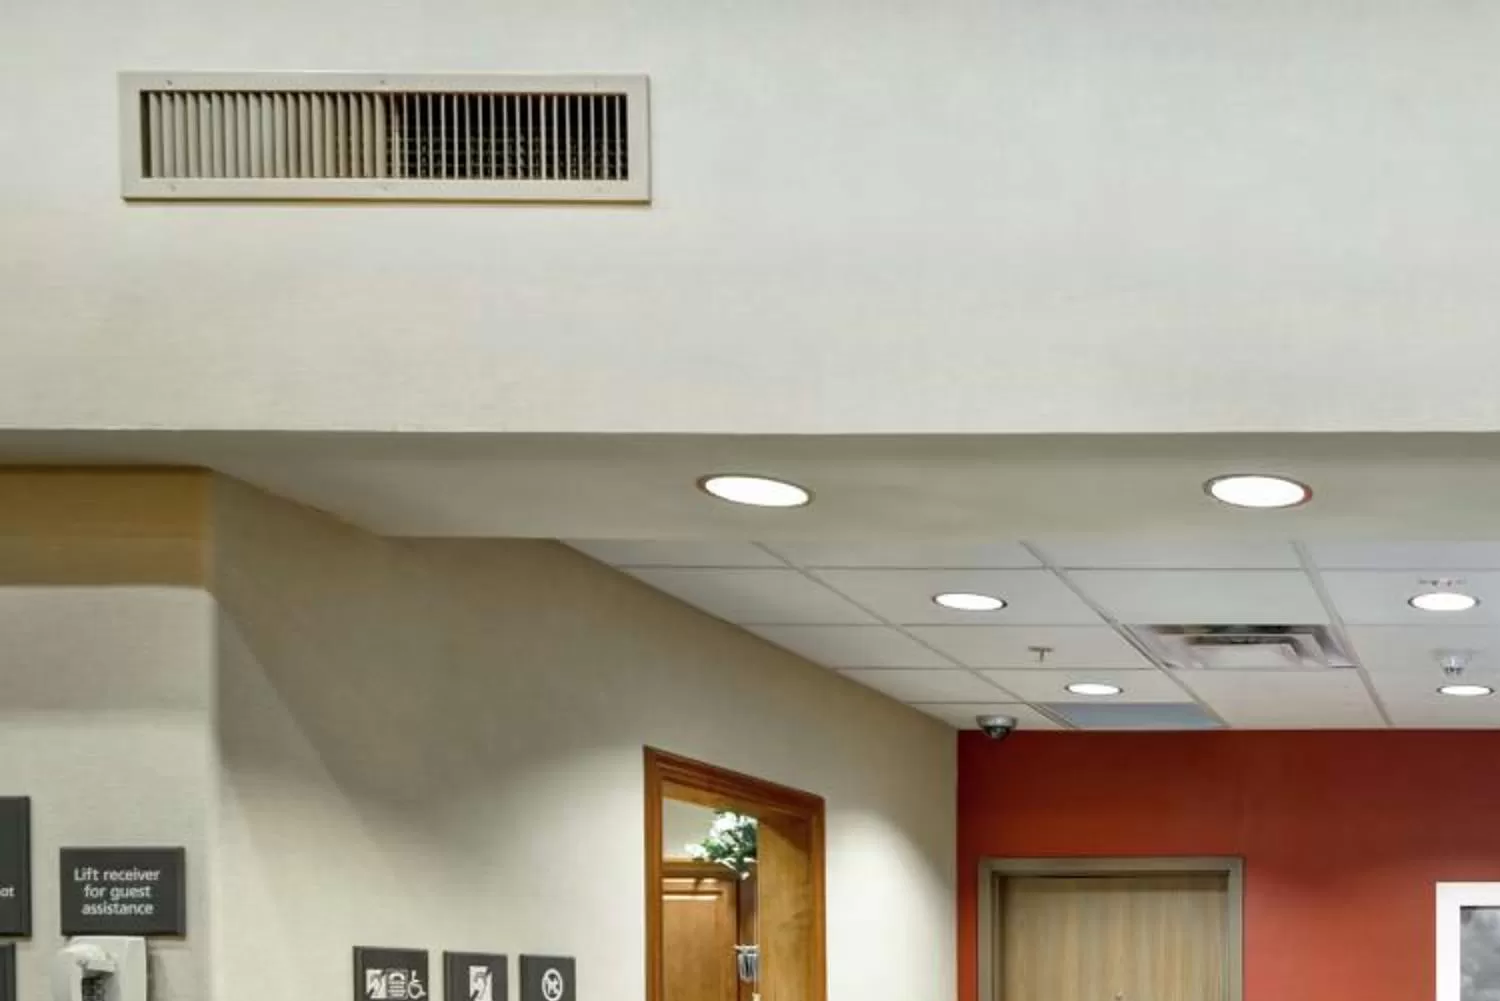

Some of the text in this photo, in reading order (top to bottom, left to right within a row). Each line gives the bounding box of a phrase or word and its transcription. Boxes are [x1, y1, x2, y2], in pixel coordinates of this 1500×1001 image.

[73, 866, 160, 881] Lift receiver
[83, 884, 152, 901] for guest
[81, 901, 154, 915] assistance
